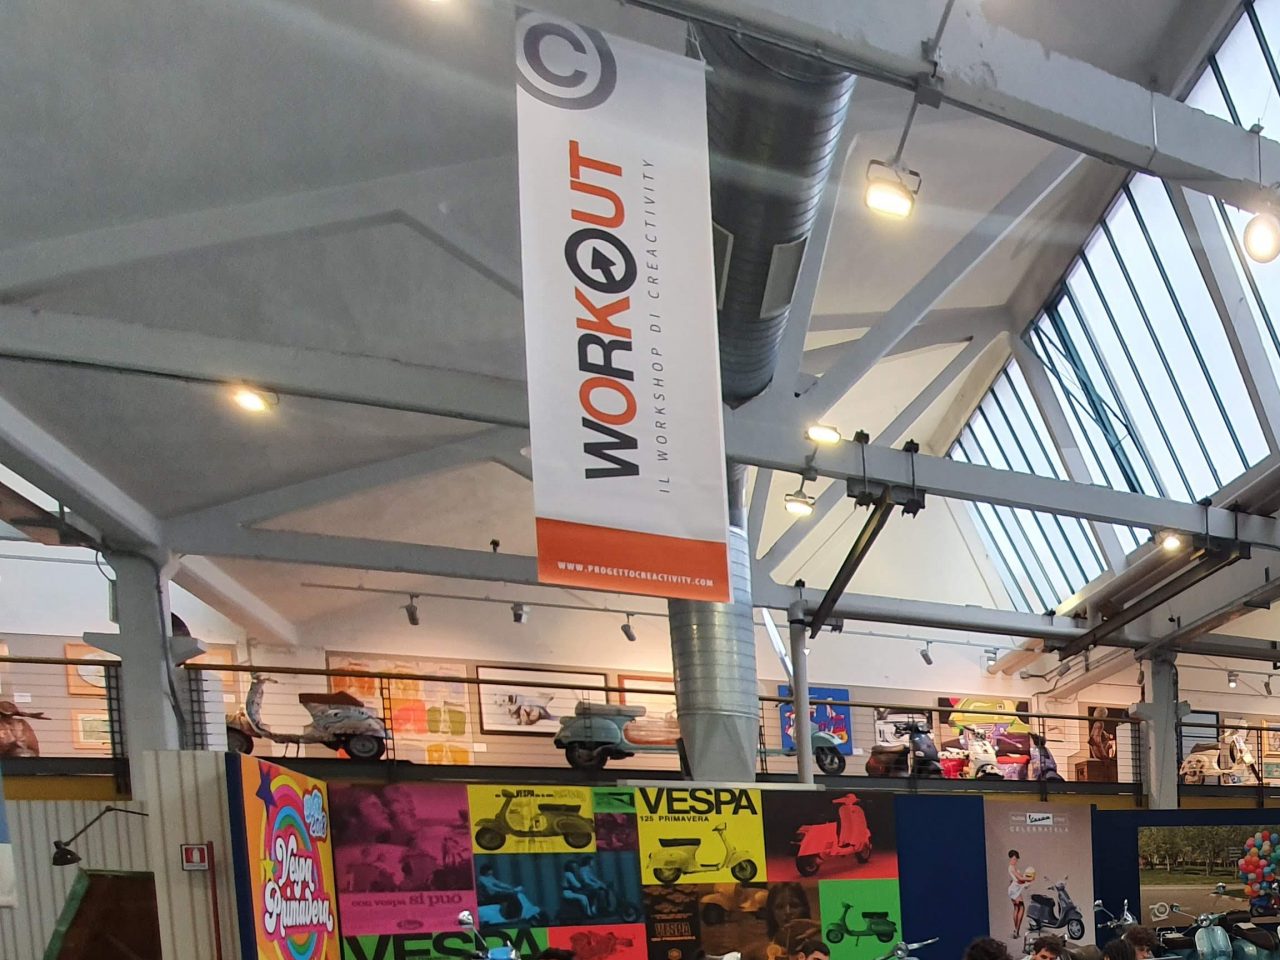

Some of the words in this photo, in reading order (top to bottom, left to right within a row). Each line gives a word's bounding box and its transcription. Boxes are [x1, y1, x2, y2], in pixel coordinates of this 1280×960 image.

[642, 159, 660, 299] CREACTIVITY
[564, 139, 640, 481] WORKOUT
[649, 313, 662, 333] DI
[651, 347, 669, 462] WORKSHOP
[658, 476, 671, 494] IL
[557, 561, 714, 587] WWW.PROGETTOCREACTIVITY.COM
[639, 787, 758, 815] VESPA
[658, 815, 710, 823] PRIMAVERA
[275, 835, 315, 898] Vespa
[264, 880, 334, 937] Primavera
